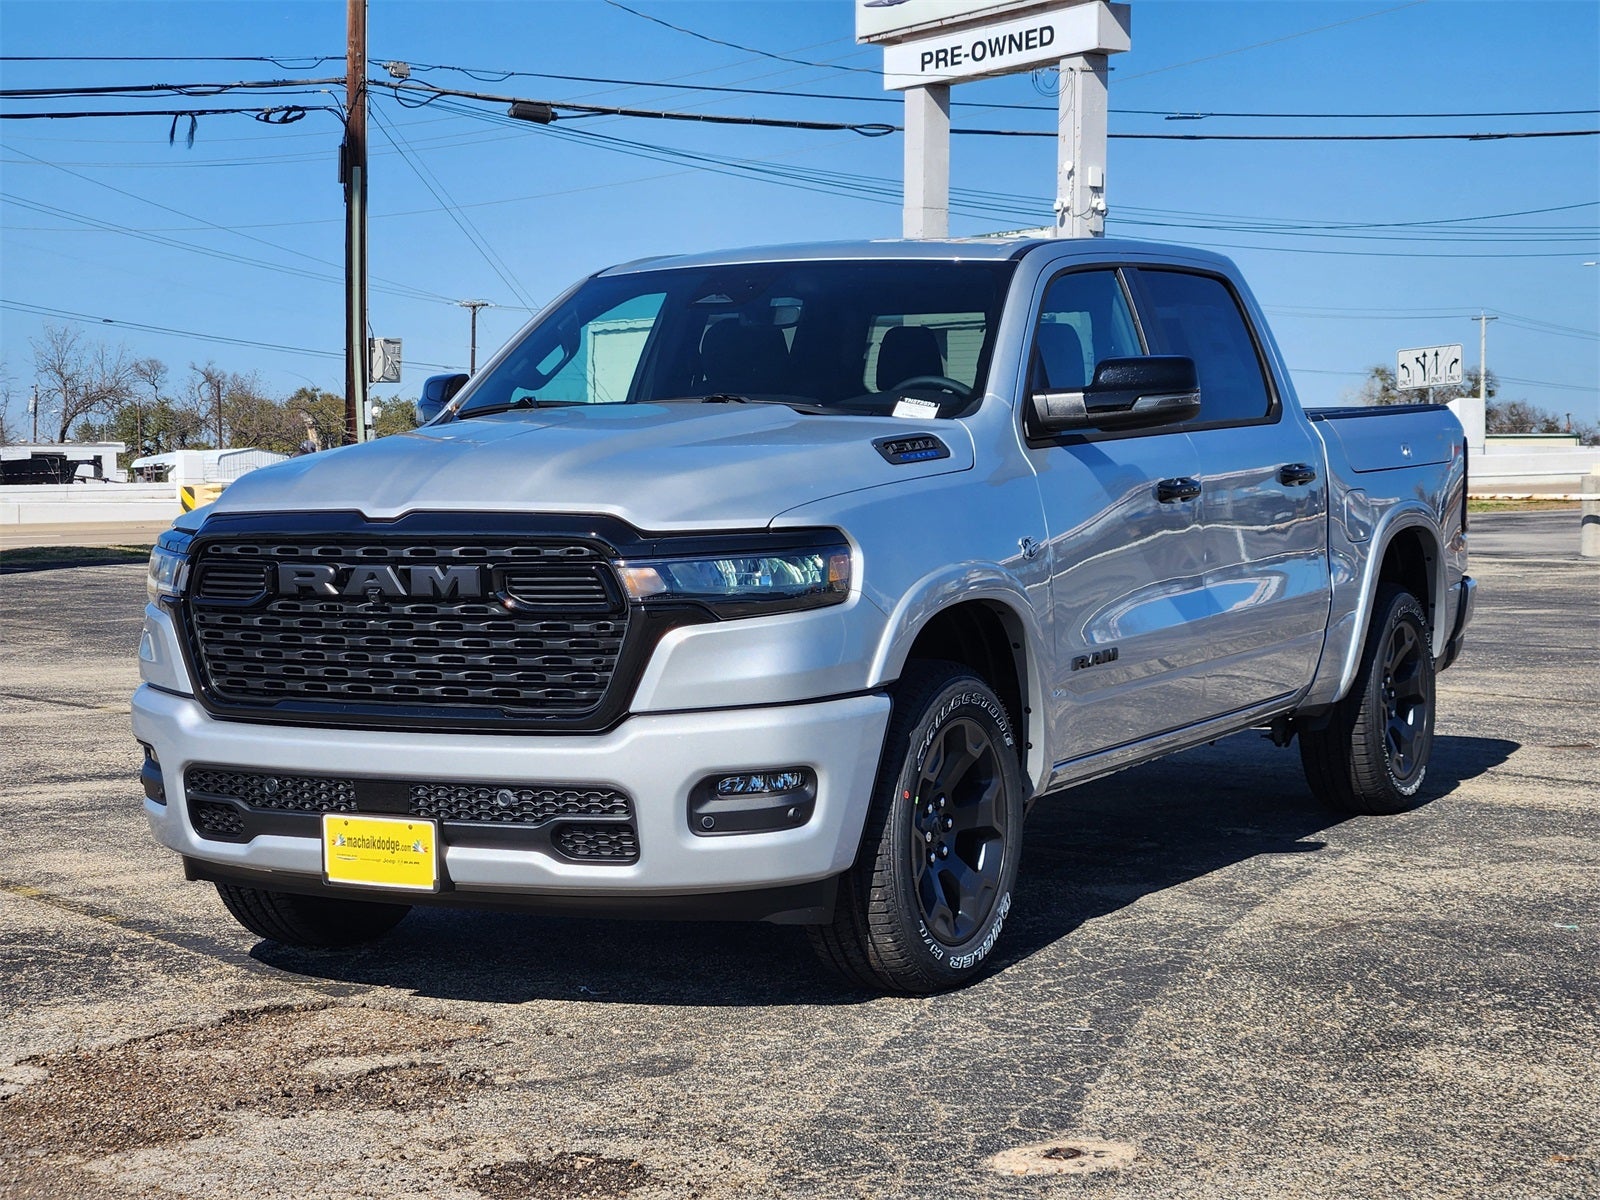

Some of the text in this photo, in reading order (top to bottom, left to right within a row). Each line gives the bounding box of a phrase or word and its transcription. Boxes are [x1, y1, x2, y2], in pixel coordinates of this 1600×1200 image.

[920, 25, 1055, 72] PRE-OWNED
[278, 563, 481, 597] RAM
[1071, 647, 1119, 671] RAM
